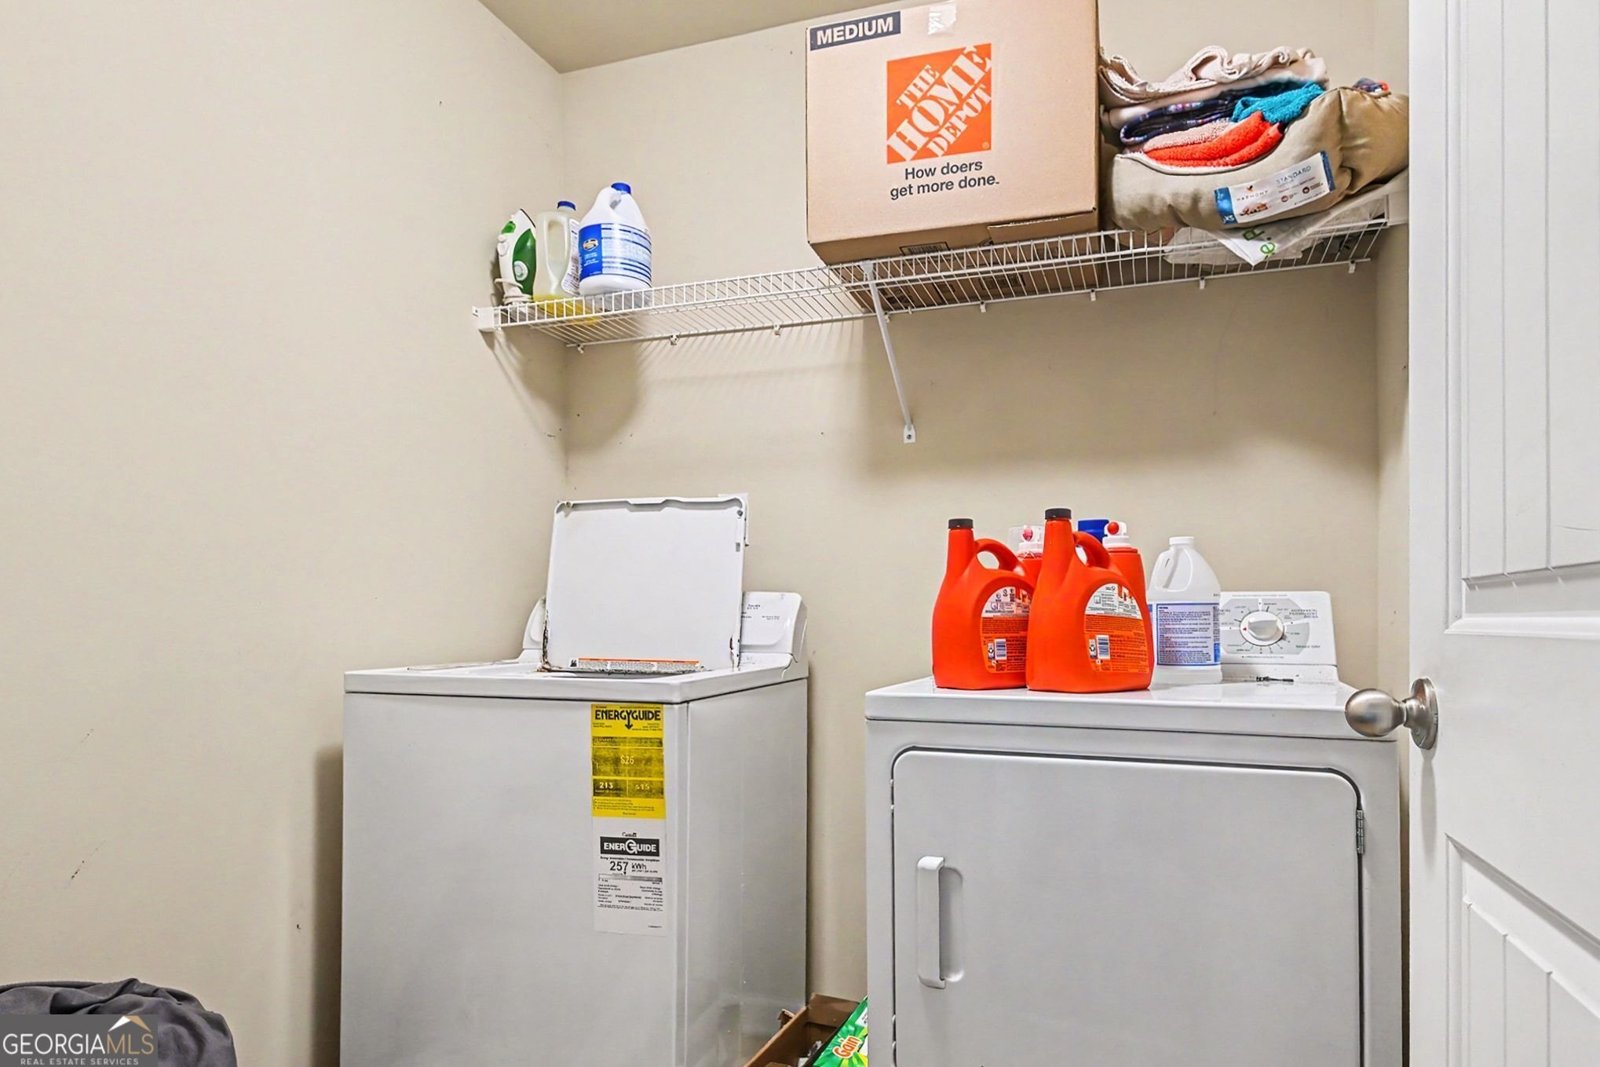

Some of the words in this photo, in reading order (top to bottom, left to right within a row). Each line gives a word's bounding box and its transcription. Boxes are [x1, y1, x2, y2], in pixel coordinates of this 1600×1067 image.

[816, 16, 894, 46] MEDIUM
[895, 64, 940, 110] THE
[886, 45, 992, 162] HOME
[926, 83, 992, 157] DEPOT
[905, 167, 937, 180] How
[941, 160, 983, 175] doers
[890, 184, 913, 200] get
[917, 180, 954, 194] more
[958, 175, 1000, 189] done.
[595, 709, 661, 721] ENERGYGUIDE
[603, 839, 657, 854] ENERGUIDE
[609, 860, 628, 873] 257
[833, 1036, 861, 1058] Gain
